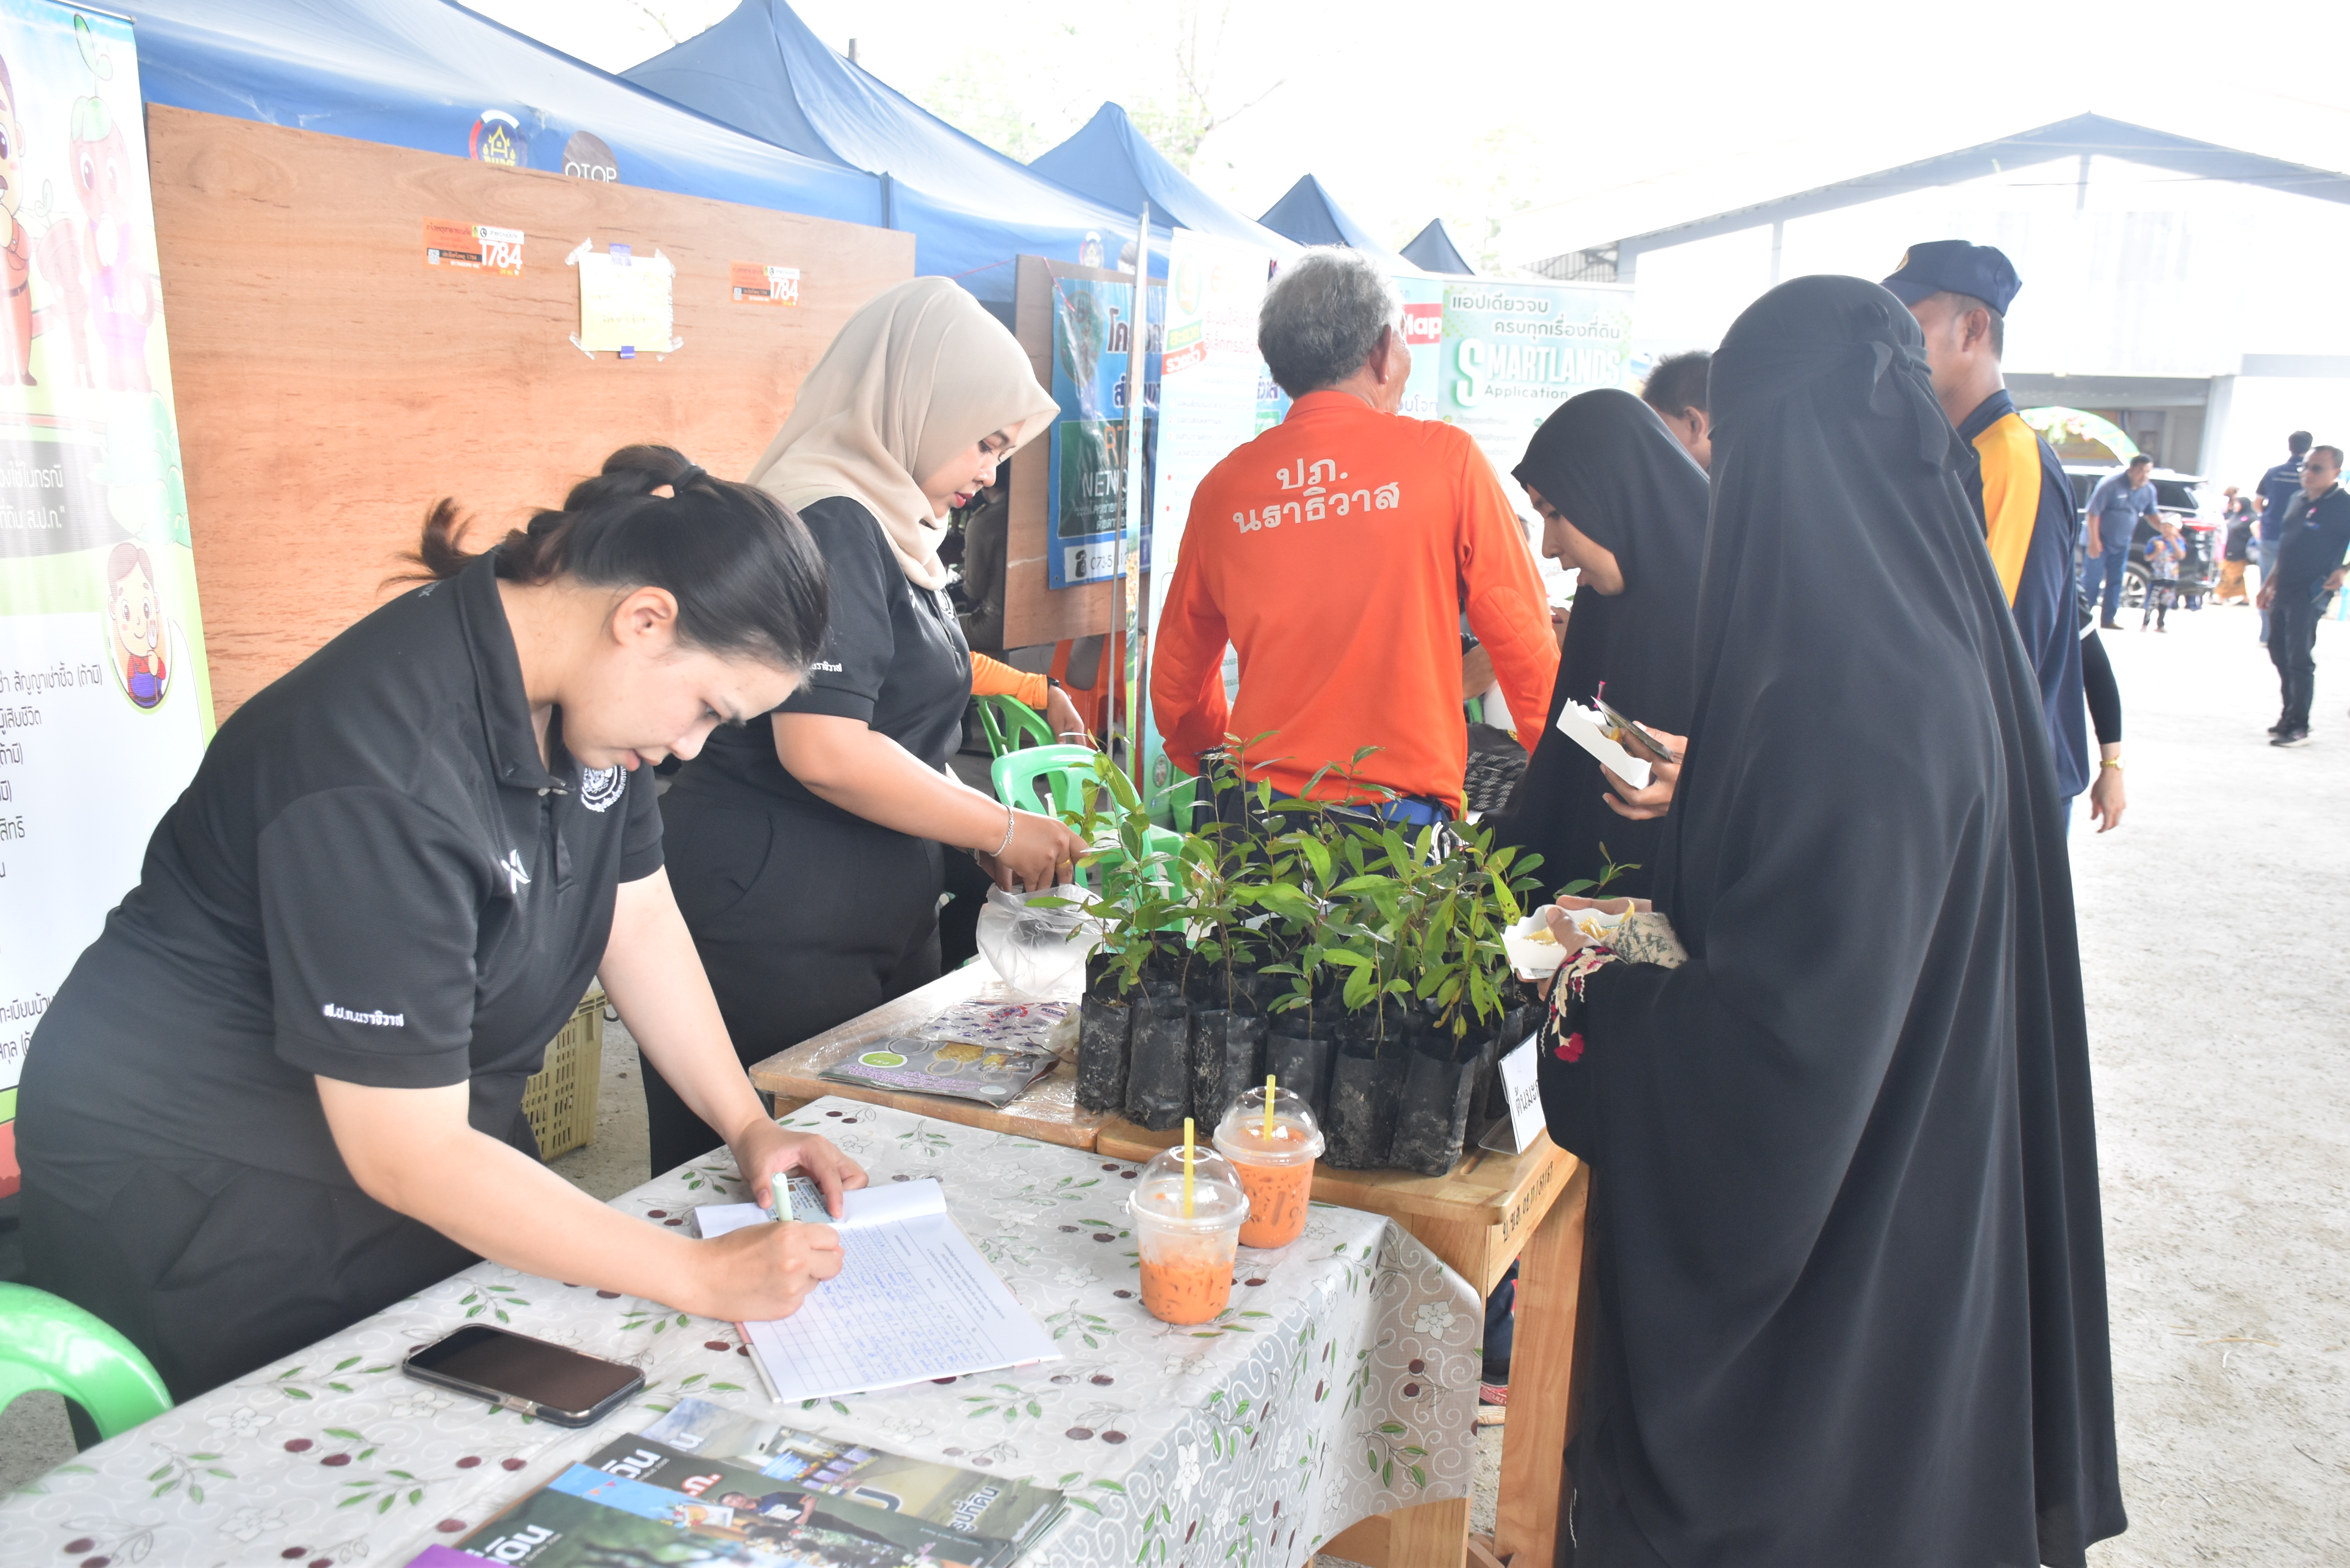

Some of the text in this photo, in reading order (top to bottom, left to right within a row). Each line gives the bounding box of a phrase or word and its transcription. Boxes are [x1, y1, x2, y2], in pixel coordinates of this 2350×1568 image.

[478, 239, 523, 270] 1784
[768, 277, 799, 302] 1784
[1452, 292, 1549, 313] แอปเดียวจบ
[1169, 324, 1200, 347] สะดวก
[1494, 314, 1620, 341] ครบทุกเรื่องที่ดิน
[1484, 385, 1569, 399] Application
[1276, 458, 1349, 490] ปภ.
[1232, 481, 1401, 534] นราธิวาส
[14, 661, 74, 696] สัญญาเช่าซื้อ
[77, 663, 103, 687] (ถ้ามี)
